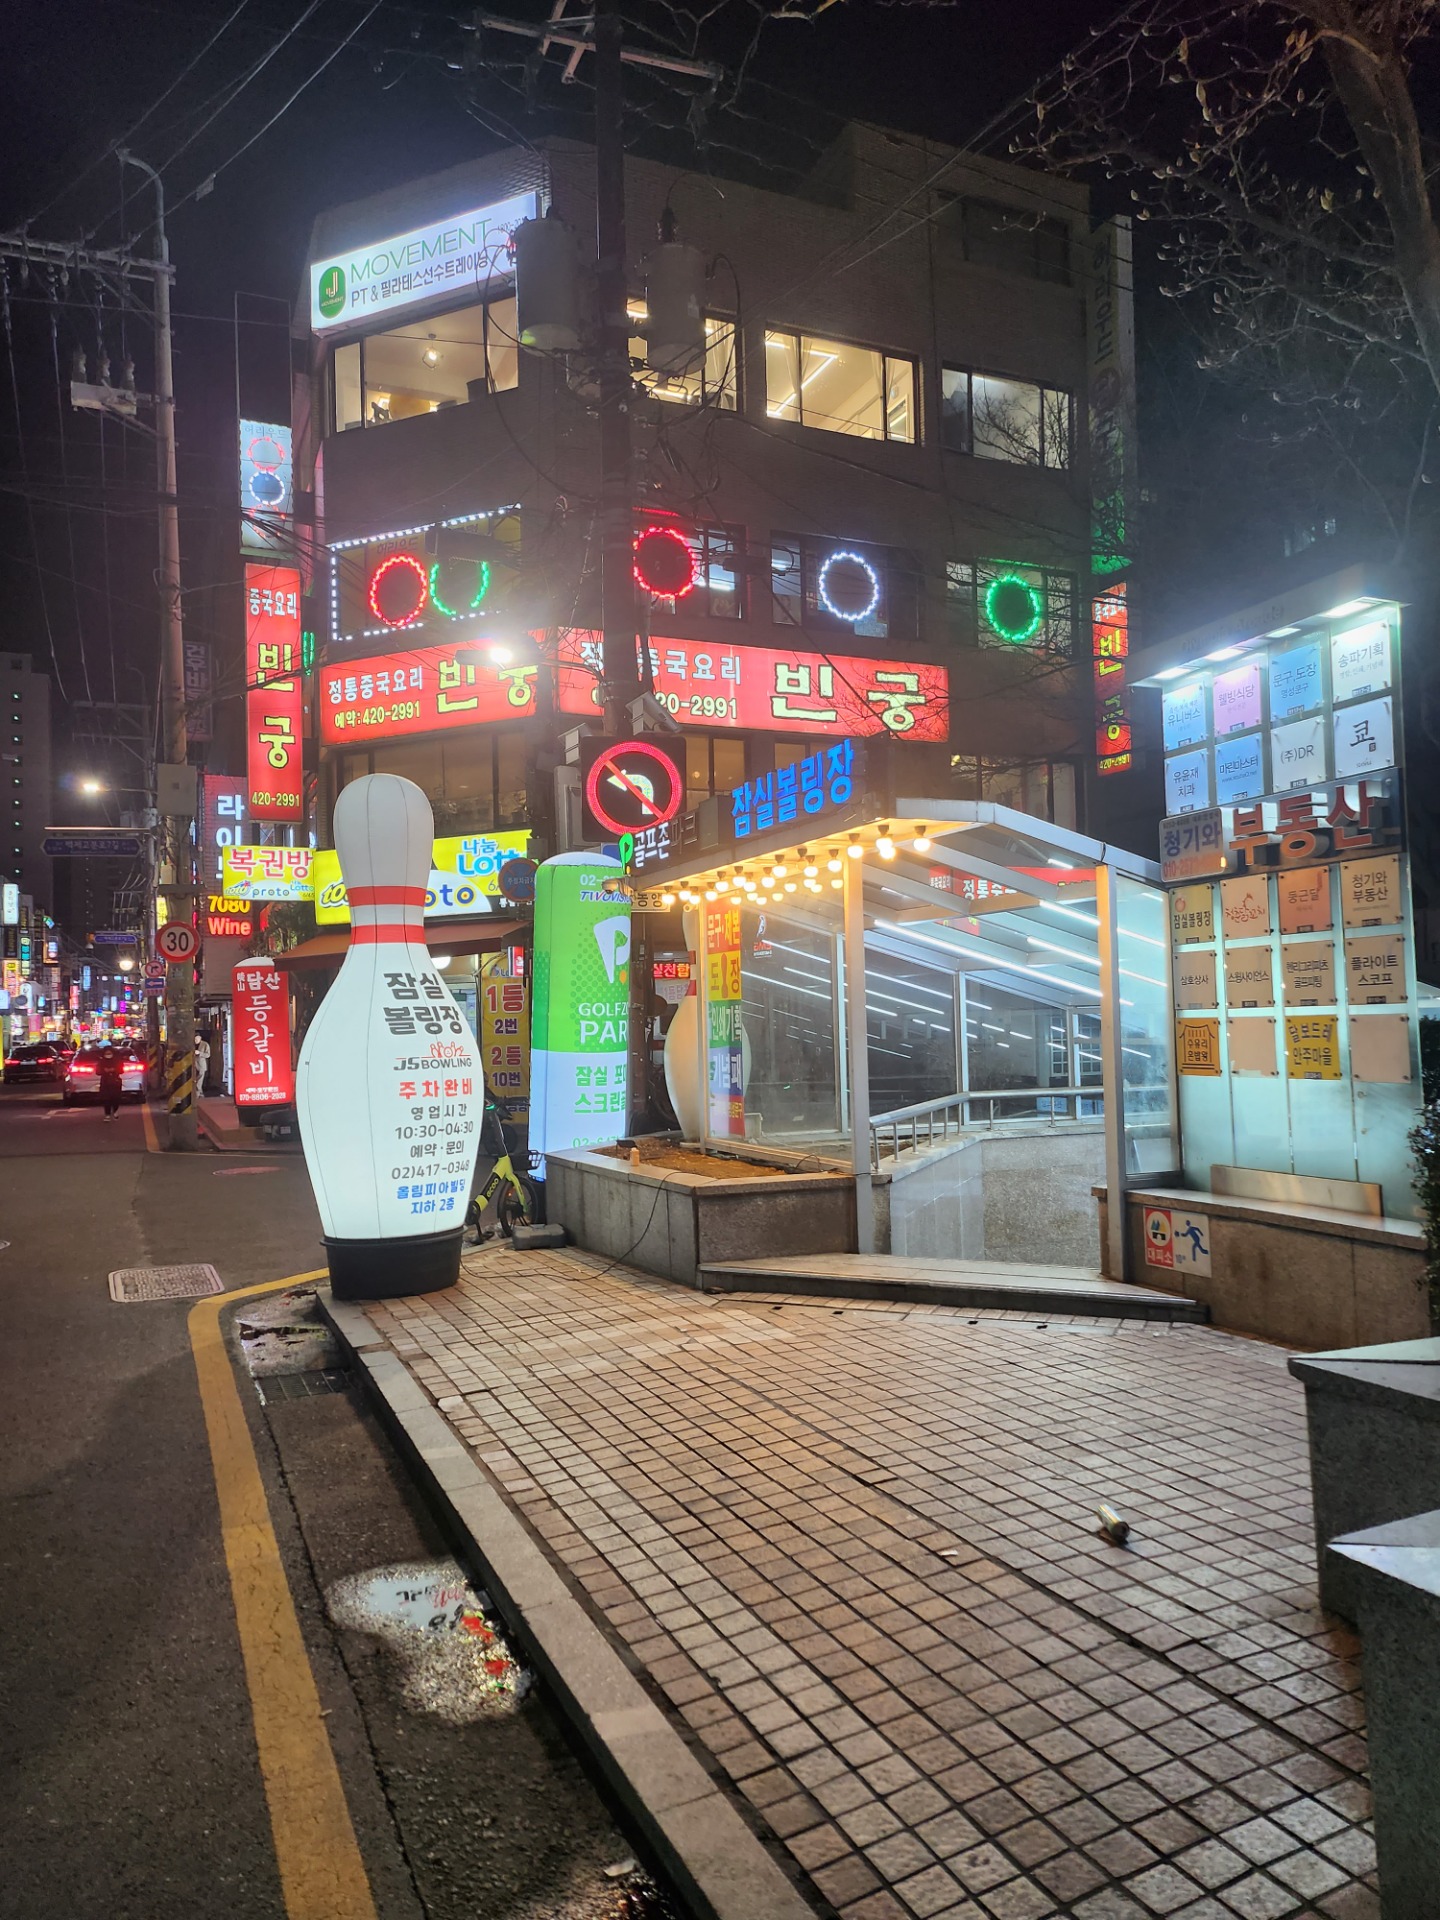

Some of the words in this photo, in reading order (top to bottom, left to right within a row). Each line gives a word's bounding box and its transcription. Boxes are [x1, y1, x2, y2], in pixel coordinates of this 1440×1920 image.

[351, 218, 492, 284] MOVEMENT
[351, 287, 368, 308] PT
[370, 285, 379, 301] &
[249, 588, 297, 619] 중국요리
[1338, 641, 1384, 668] 송파기획
[328, 665, 423, 704] 정통중국요리
[1218, 684, 1255, 707] 웰빙식당
[257, 643, 297, 769] 빈궁
[1219, 755, 1259, 775] 마린마스터
[1280, 746, 1314, 765] (주)DR
[731, 738, 855, 839] 잠실볼링장
[1178, 784, 1196, 797] 치과
[252, 791, 300, 807] 420-2991
[1164, 823, 1221, 856] 청기와
[1229, 780, 1375, 866] 부동산
[462, 838, 498, 854] 나눔
[228, 848, 314, 879] 복권방
[1352, 871, 1388, 889] 청기와
[252, 888, 290, 898] proto
[1352, 887, 1389, 904] 부동산
[208, 895, 250, 913] 7080
[208, 917, 251, 936] Wine
[1173, 911, 1211, 930] 잠실볼링장
[166, 931, 190, 952] 30
[246, 971, 280, 991] 담산
[383, 972, 447, 1001] 잠실
[1357, 973, 1394, 987] 스코프
[486, 984, 524, 1012] 1등
[382, 1005, 464, 1036] 볼링장
[494, 1018, 518, 1035] 2번
[245, 994, 274, 1083] 등갈비
[1187, 1039, 1209, 1050] 수유리
[393, 1056, 473, 1071] JSBOWLING
[1292, 1046, 1333, 1067] 안주마을
[492, 1072, 521, 1087] 10번
[575, 1065, 608, 1087] 잠실
[399, 1077, 473, 1100] 주차완비
[410, 1104, 468, 1121] 영업시간
[395, 1121, 474, 1140] 10:30~04:30
[391, 1159, 470, 1180] 02)417-0348
[396, 1178, 466, 1200] 올림피아빌딩
[410, 1201, 436, 1215] 지하
[439, 1197, 455, 1211] 2층
[1147, 1247, 1173, 1264] 대피소
